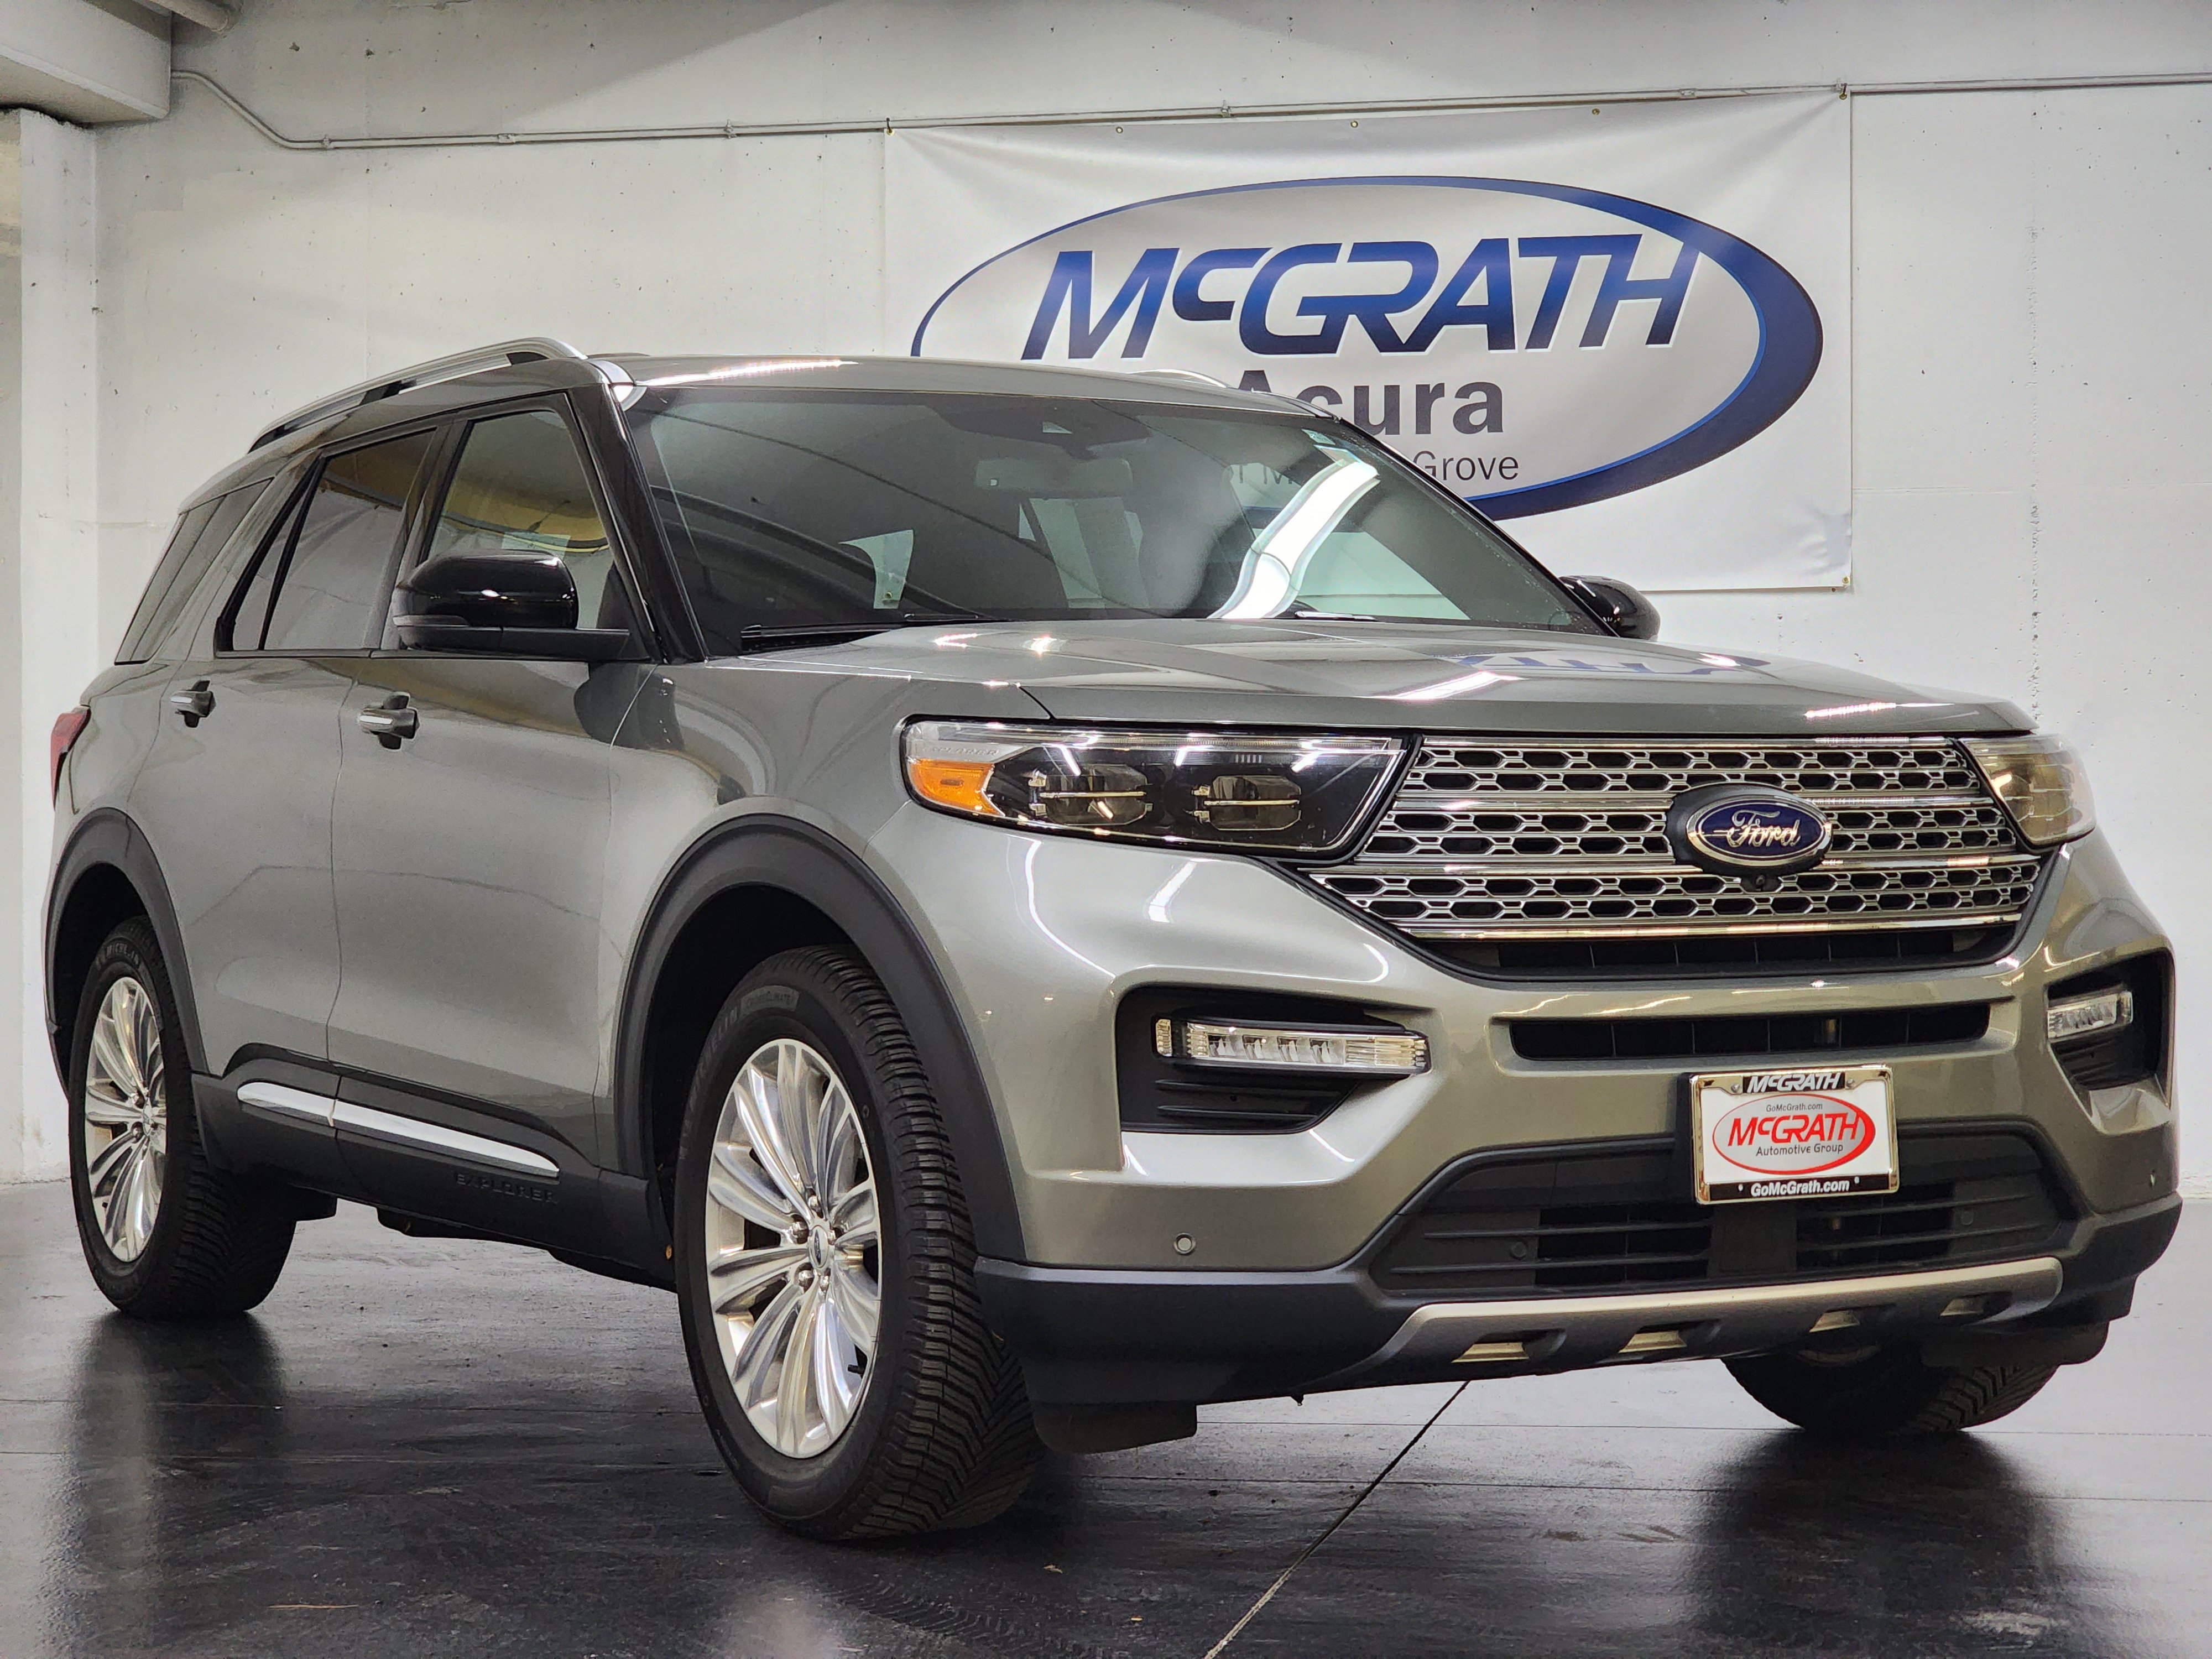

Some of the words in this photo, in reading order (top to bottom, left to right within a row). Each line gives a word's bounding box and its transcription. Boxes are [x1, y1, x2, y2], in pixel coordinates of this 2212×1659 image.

[1412, 450, 1519, 482] Grove
[1726, 810, 1801, 848] Ford
[1766, 1103, 1823, 1113] GoMcGrath.com
[1756, 1145, 1812, 1156] Automotive
[1814, 1143, 1844, 1155] Group
[1750, 1179, 1850, 1198] GoMcGrath.com
